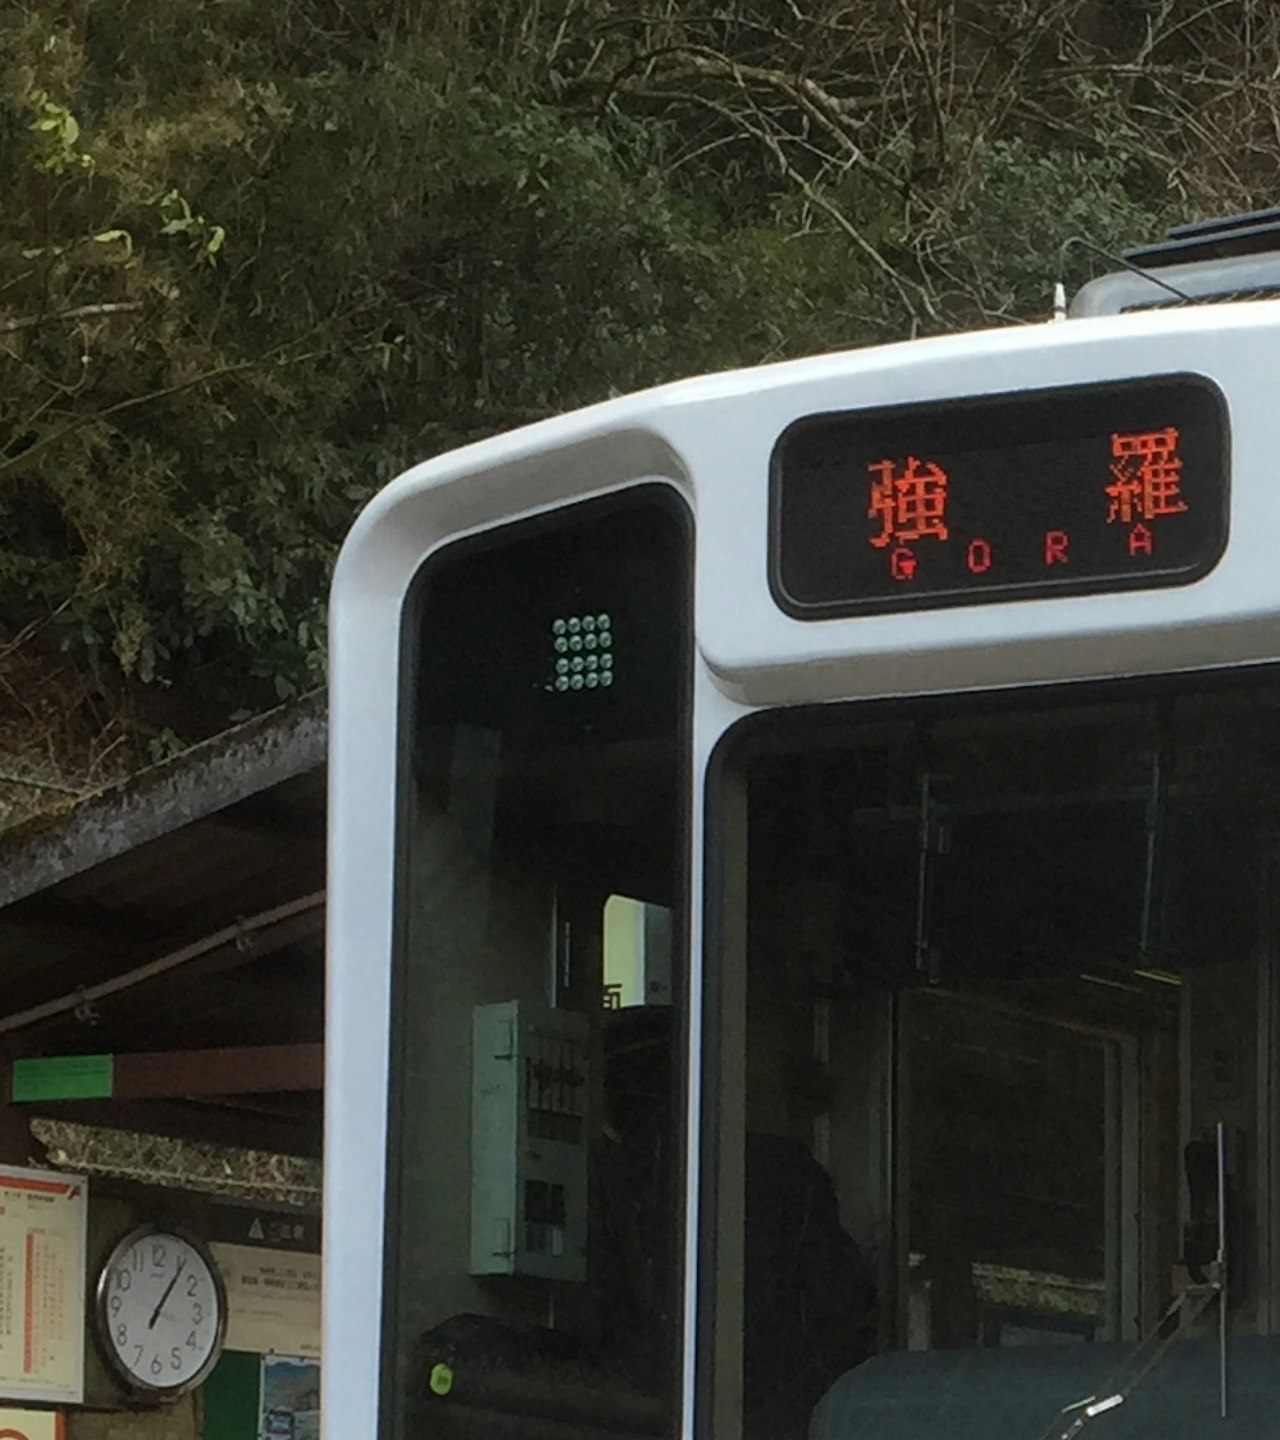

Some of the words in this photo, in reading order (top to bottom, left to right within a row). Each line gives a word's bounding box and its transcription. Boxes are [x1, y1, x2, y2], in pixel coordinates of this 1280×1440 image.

[867, 427, 1190, 547] 強羅
[891, 524, 1152, 581] GORA
[152, 1245, 166, 1268] 12
[116, 1269, 131, 1292] 10
[186, 1274, 198, 1297] 2
[110, 1295, 122, 1318] 9
[192, 1303, 204, 1325] 3
[116, 1324, 127, 1346] 8
[186, 1330, 197, 1351] 4
[134, 1345, 144, 1367] 7
[151, 1353, 162, 1375] 6
[171, 1347, 183, 1370] 5
